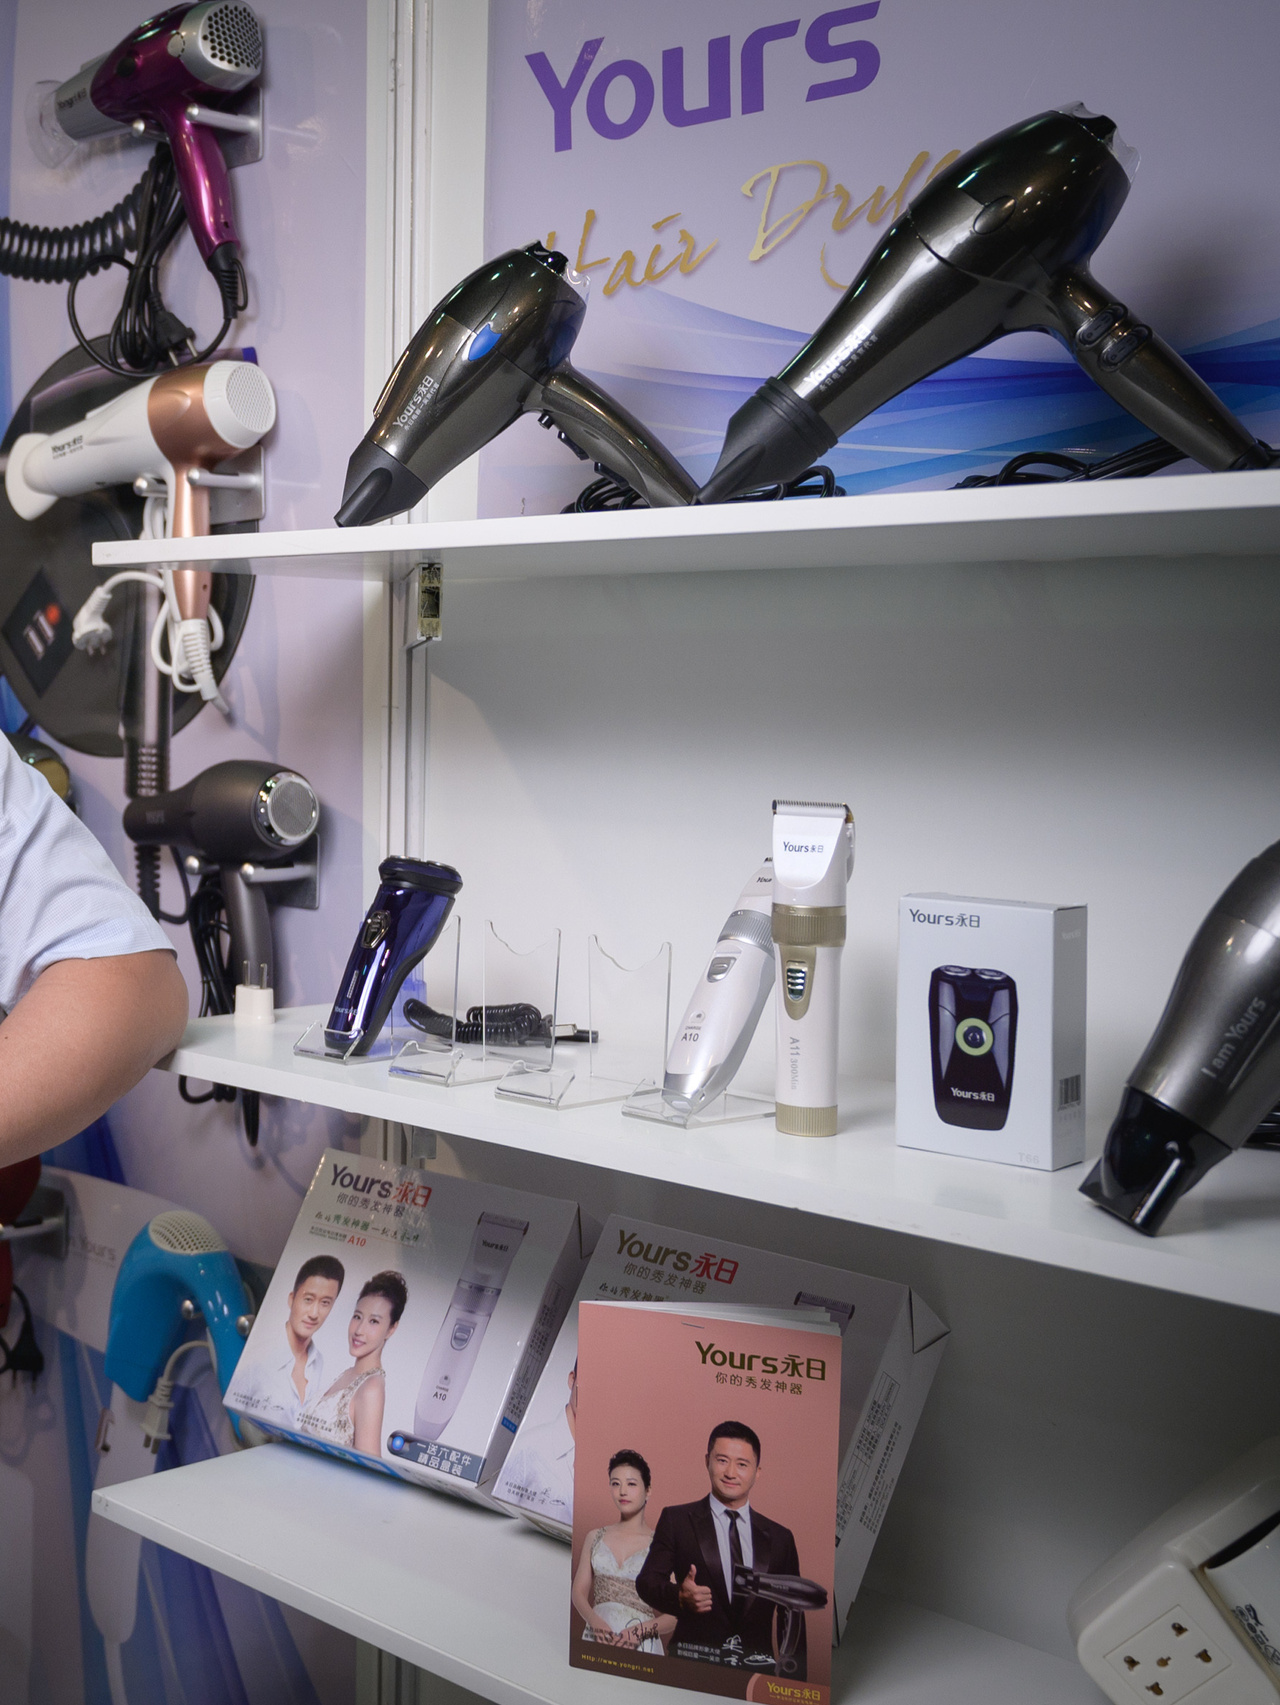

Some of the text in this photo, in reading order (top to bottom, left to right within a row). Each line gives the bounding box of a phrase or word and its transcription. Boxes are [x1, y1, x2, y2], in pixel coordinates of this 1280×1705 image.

[524, 0, 881, 153] Yours
[392, 375, 434, 428] Yours永日
[783, 841, 824, 854] Yours永日
[909, 908, 981, 928] Yours永日
[681, 1033, 700, 1042] A10
[789, 1036, 801, 1056] A11
[1200, 997, 1267, 1079] I am Yours
[950, 1087, 995, 1102] Yours永日
[331, 1163, 433, 1208] Yours永日
[336, 1192, 406, 1217] 你的秀发神器
[347, 1235, 367, 1247] A10
[616, 1229, 739, 1285] Yours永日
[623, 1261, 708, 1295] 你的秀发神器
[695, 1340, 826, 1381] Yours永日
[715, 1371, 803, 1395] 你的秀发神器
[433, 1391, 447, 1401] A10
[417, 1442, 472, 1467] 一送六配件
[417, 1452, 463, 1476] 精品盒装
[767, 1681, 821, 1701] Yours永日
